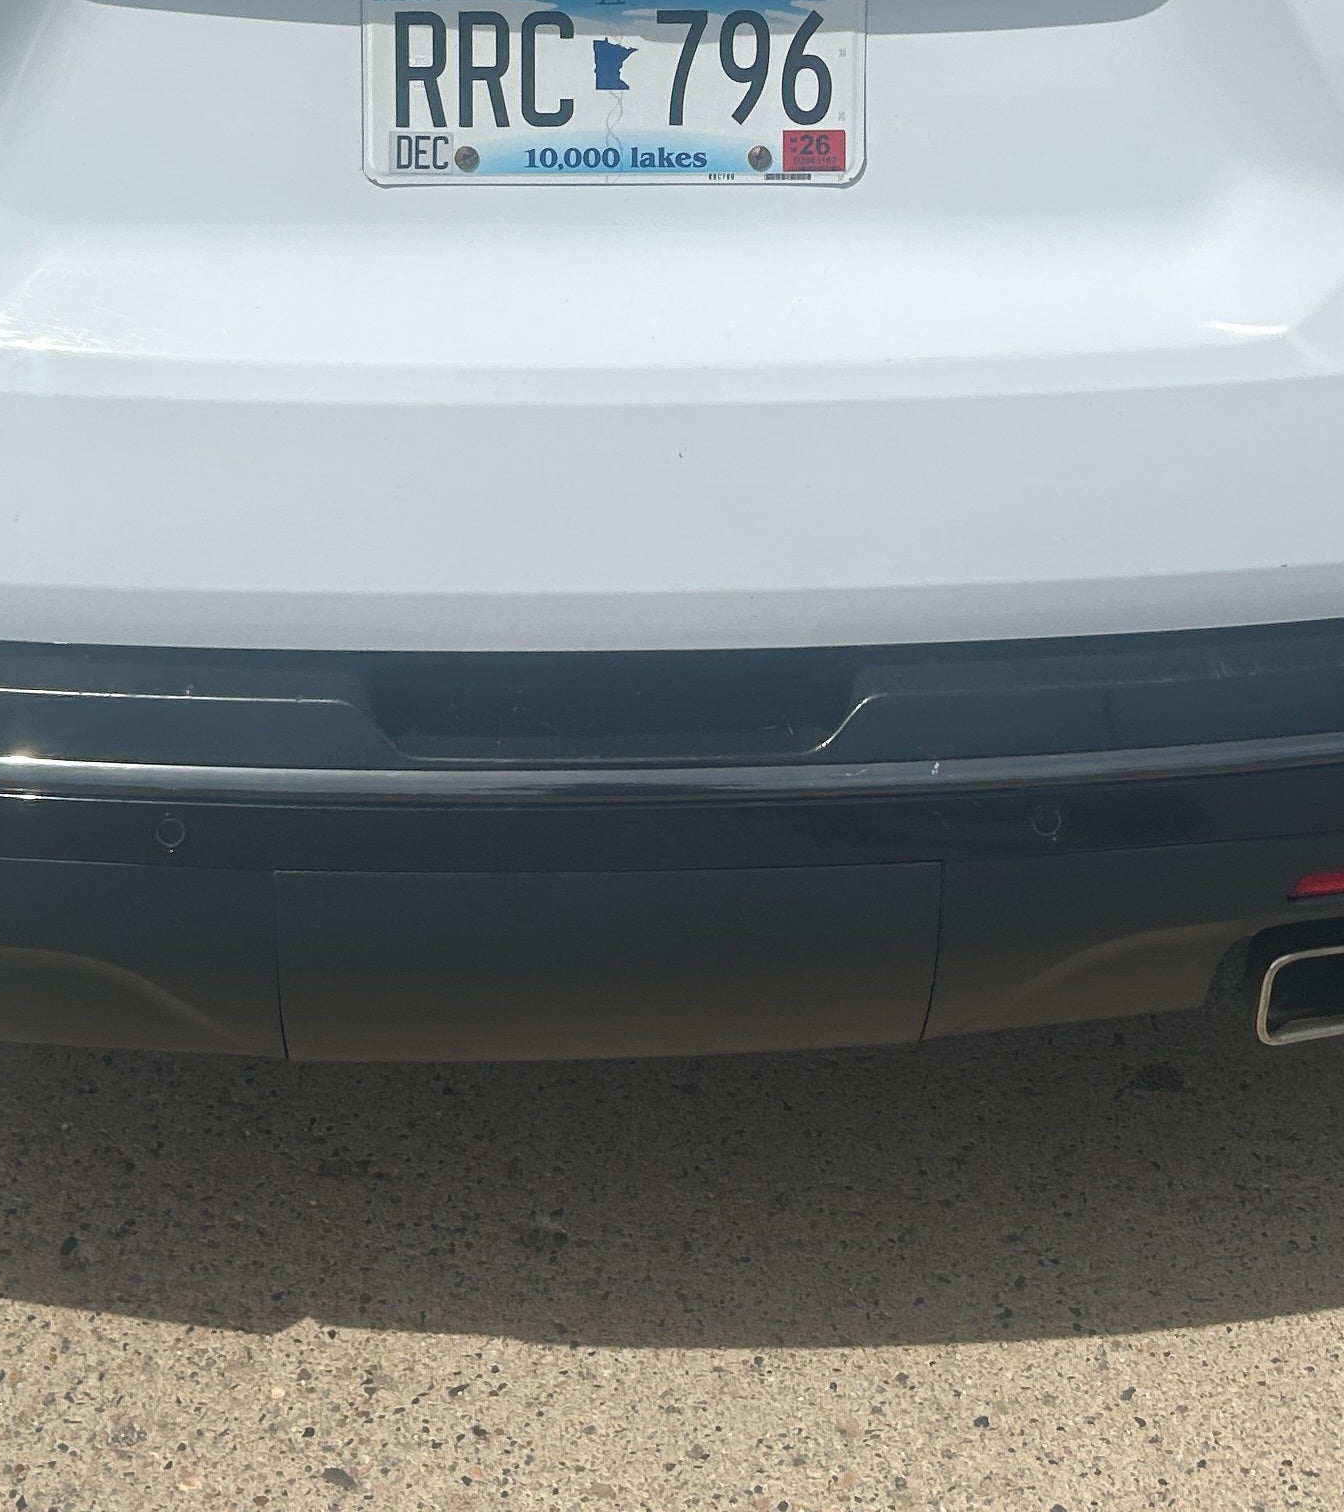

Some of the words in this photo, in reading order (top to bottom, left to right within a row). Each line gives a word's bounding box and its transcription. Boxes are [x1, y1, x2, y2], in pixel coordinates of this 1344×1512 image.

[394, 10, 575, 129] RRC
[655, 9, 833, 127] 796
[396, 135, 450, 171] DEC
[523, 147, 622, 171] 10,000
[630, 146, 708, 169] lakes
[799, 134, 831, 156] 26
